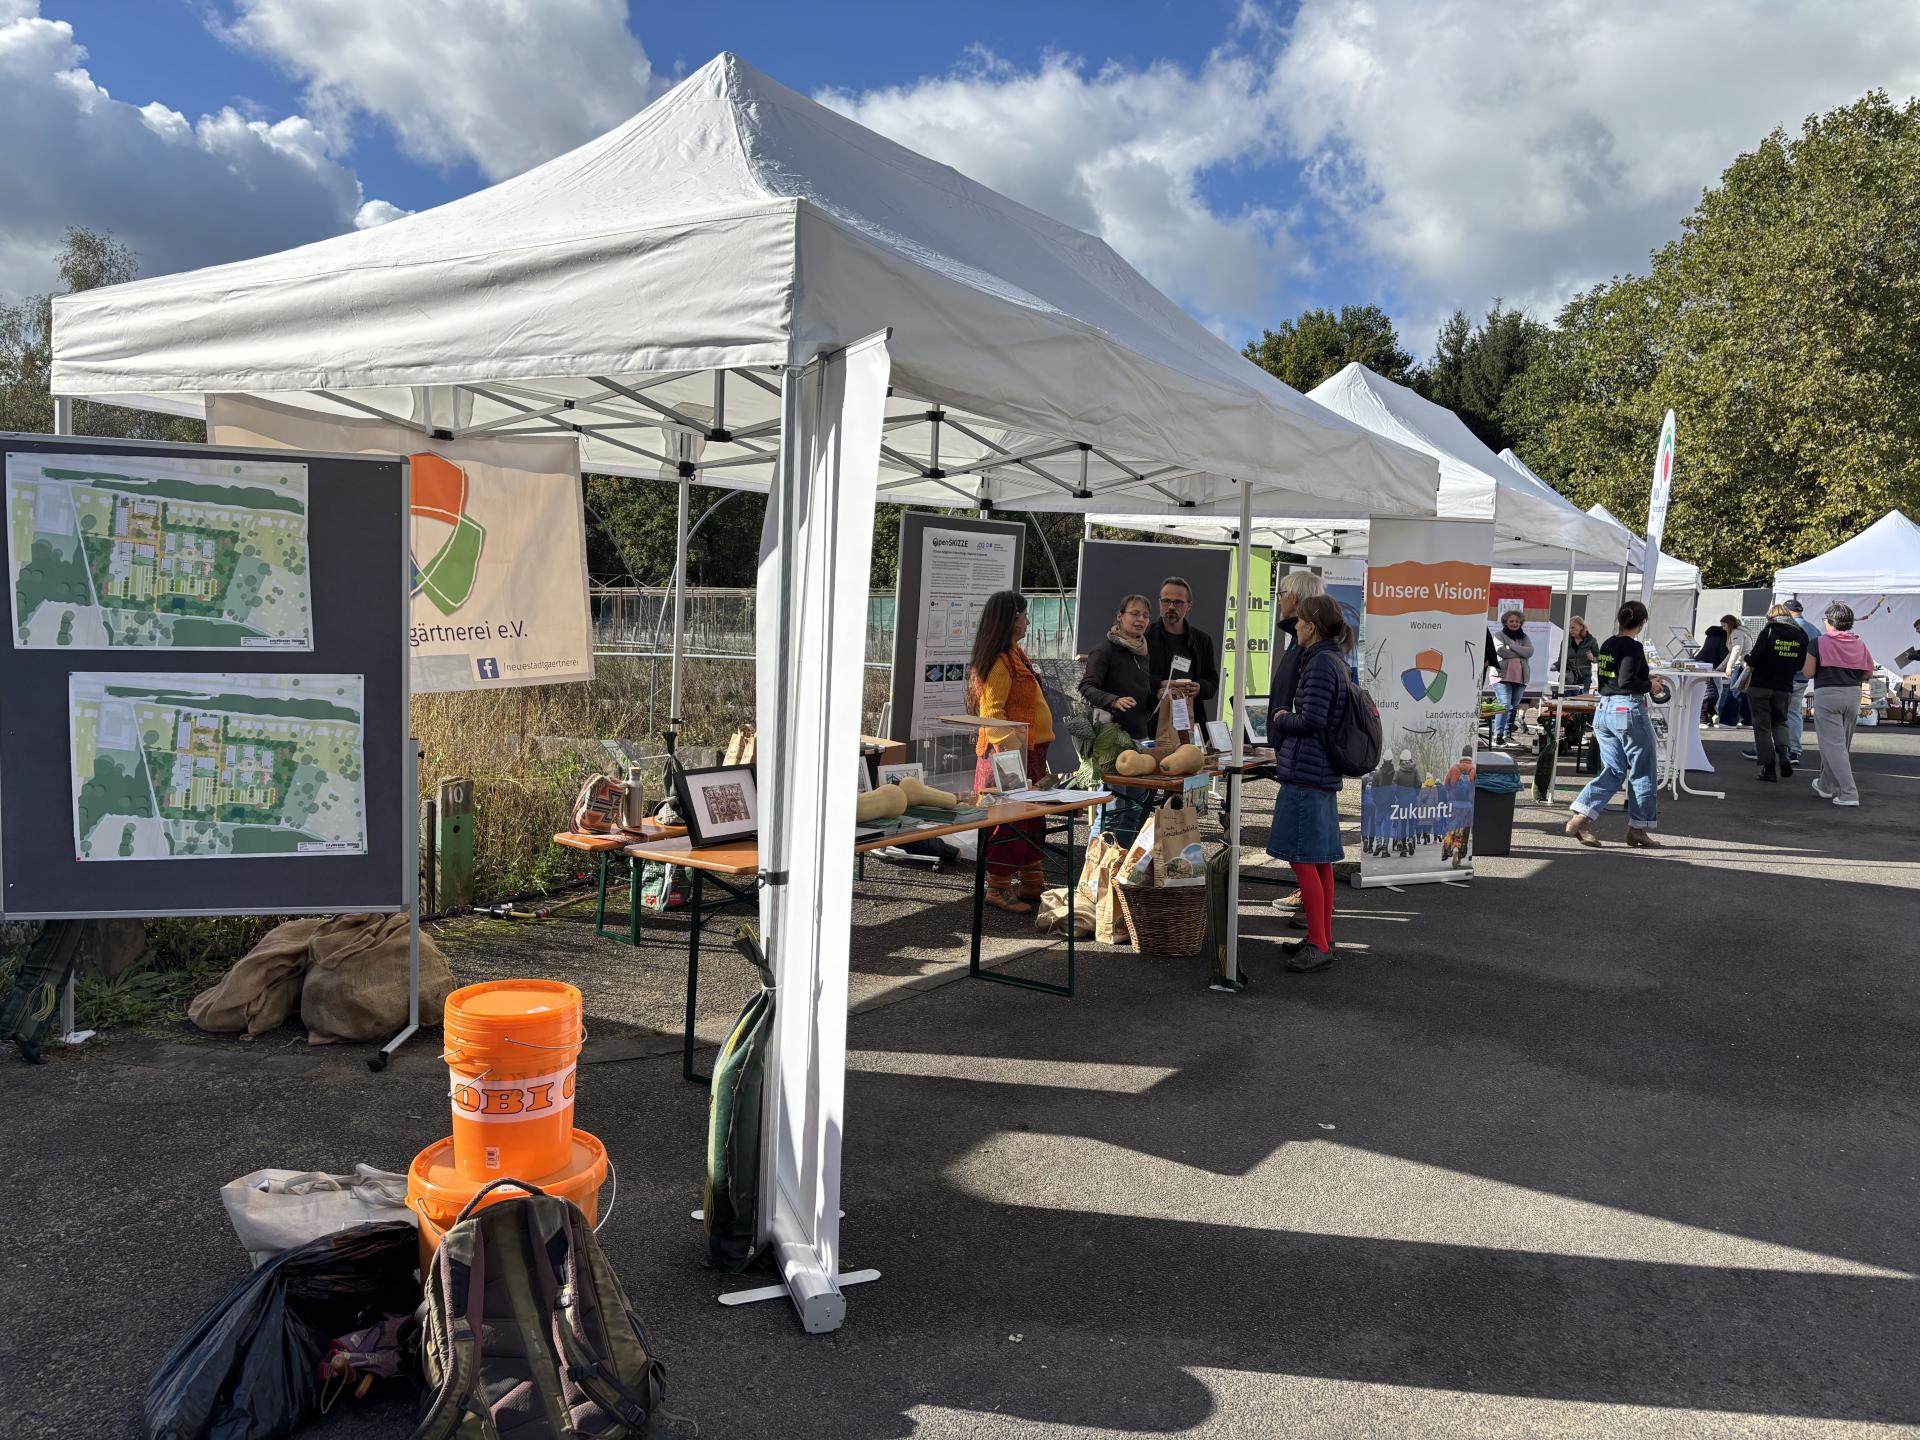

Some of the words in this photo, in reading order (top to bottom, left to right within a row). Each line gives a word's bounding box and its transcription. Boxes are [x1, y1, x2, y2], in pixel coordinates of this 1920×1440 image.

[1372, 581, 1429, 599] Unsere
[1434, 581, 1487, 600] Vision:
[409, 620, 491, 647] gärtnerei
[498, 620, 528, 639] e.V.
[1410, 621, 1442, 630] Wohnen
[1390, 802, 1453, 820] Zukunft!
[455, 1081, 555, 1115] OBI
